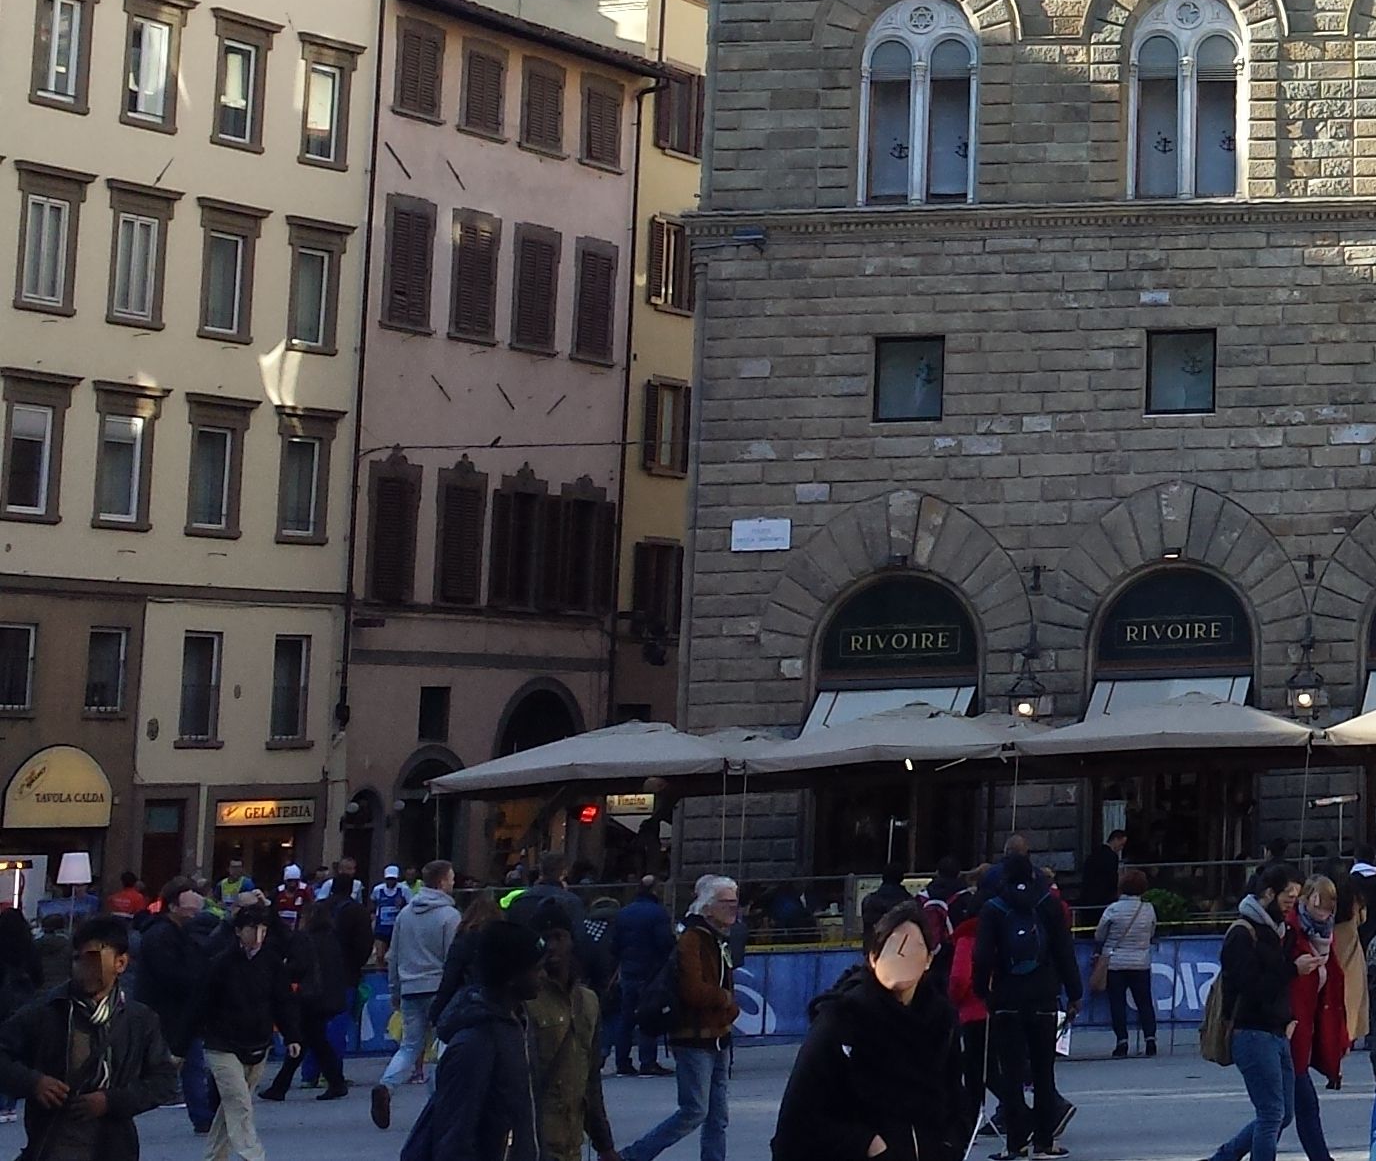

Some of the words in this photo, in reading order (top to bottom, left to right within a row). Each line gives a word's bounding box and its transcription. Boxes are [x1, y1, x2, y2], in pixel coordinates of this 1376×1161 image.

[1126, 622, 1222, 641] RIVOIRE
[850, 632, 950, 651] RIVOIRE
[35, 791, 73, 803] TAVOLA
[74, 791, 105, 803] CALDA
[244, 805, 312, 819] GELATERIA
